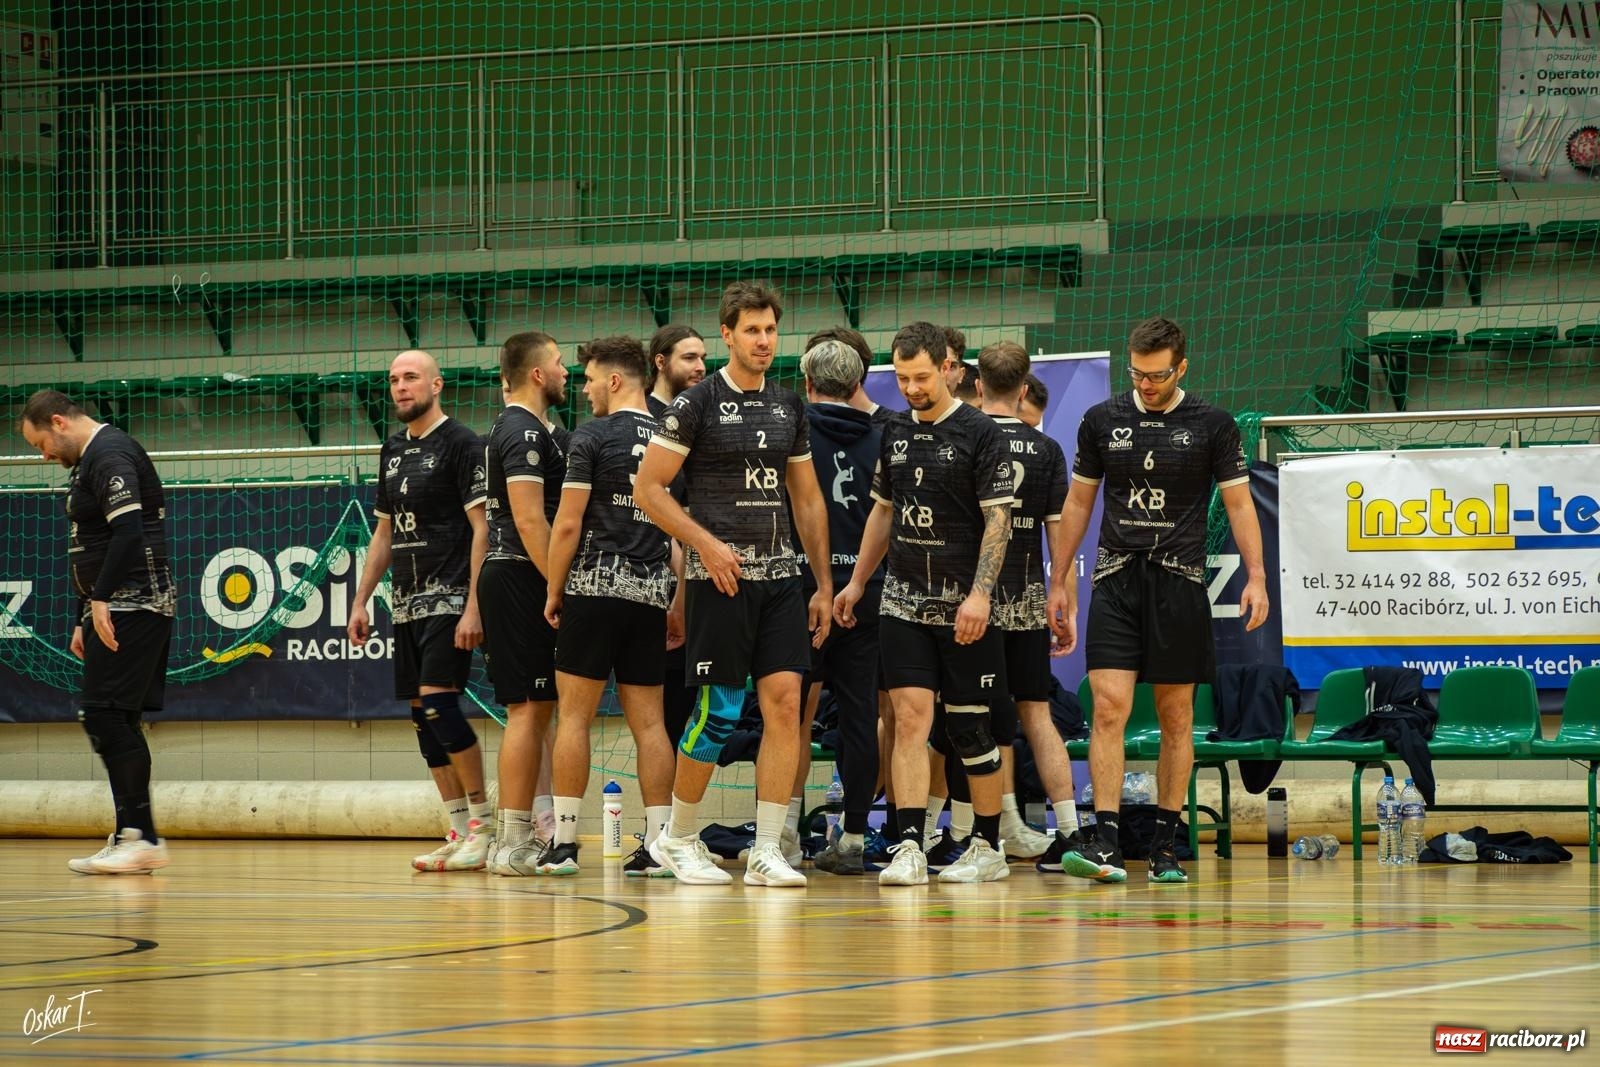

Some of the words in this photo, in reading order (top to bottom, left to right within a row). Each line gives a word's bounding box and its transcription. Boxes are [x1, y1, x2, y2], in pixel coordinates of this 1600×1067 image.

[1535, 1, 1600, 39] MI
[1546, 53, 1598, 63] poszukuje
[637, 426, 654, 440] CIT
[756, 431, 767, 448] 2
[1109, 440, 1132, 448] radlin
[1143, 451, 1154, 470] 6
[400, 477, 409, 495] 4
[745, 468, 778, 489] KB
[914, 467, 923, 487] 9
[1128, 488, 1166, 509] KB
[902, 505, 933, 527] KB
[1013, 517, 1034, 529] KLUB
[1303, 573, 1330, 589] tel.
[1335, 574, 1356, 590] 32
[1362, 573, 1395, 589] 414
[1400, 573, 1421, 589] 92
[1428, 571, 1455, 589] 88,
[1466, 572, 1500, 588] 502
[1507, 571, 1541, 587] 632
[1547, 570, 1587, 588] 695,
[1316, 600, 1381, 617] 47-400
[1387, 598, 1470, 617] Racibórz,
[1475, 598, 1497, 615] ul.
[1503, 598, 1516, 615] J.
[1522, 601, 1556, 614] von
[1563, 596, 1600, 614] Eich
